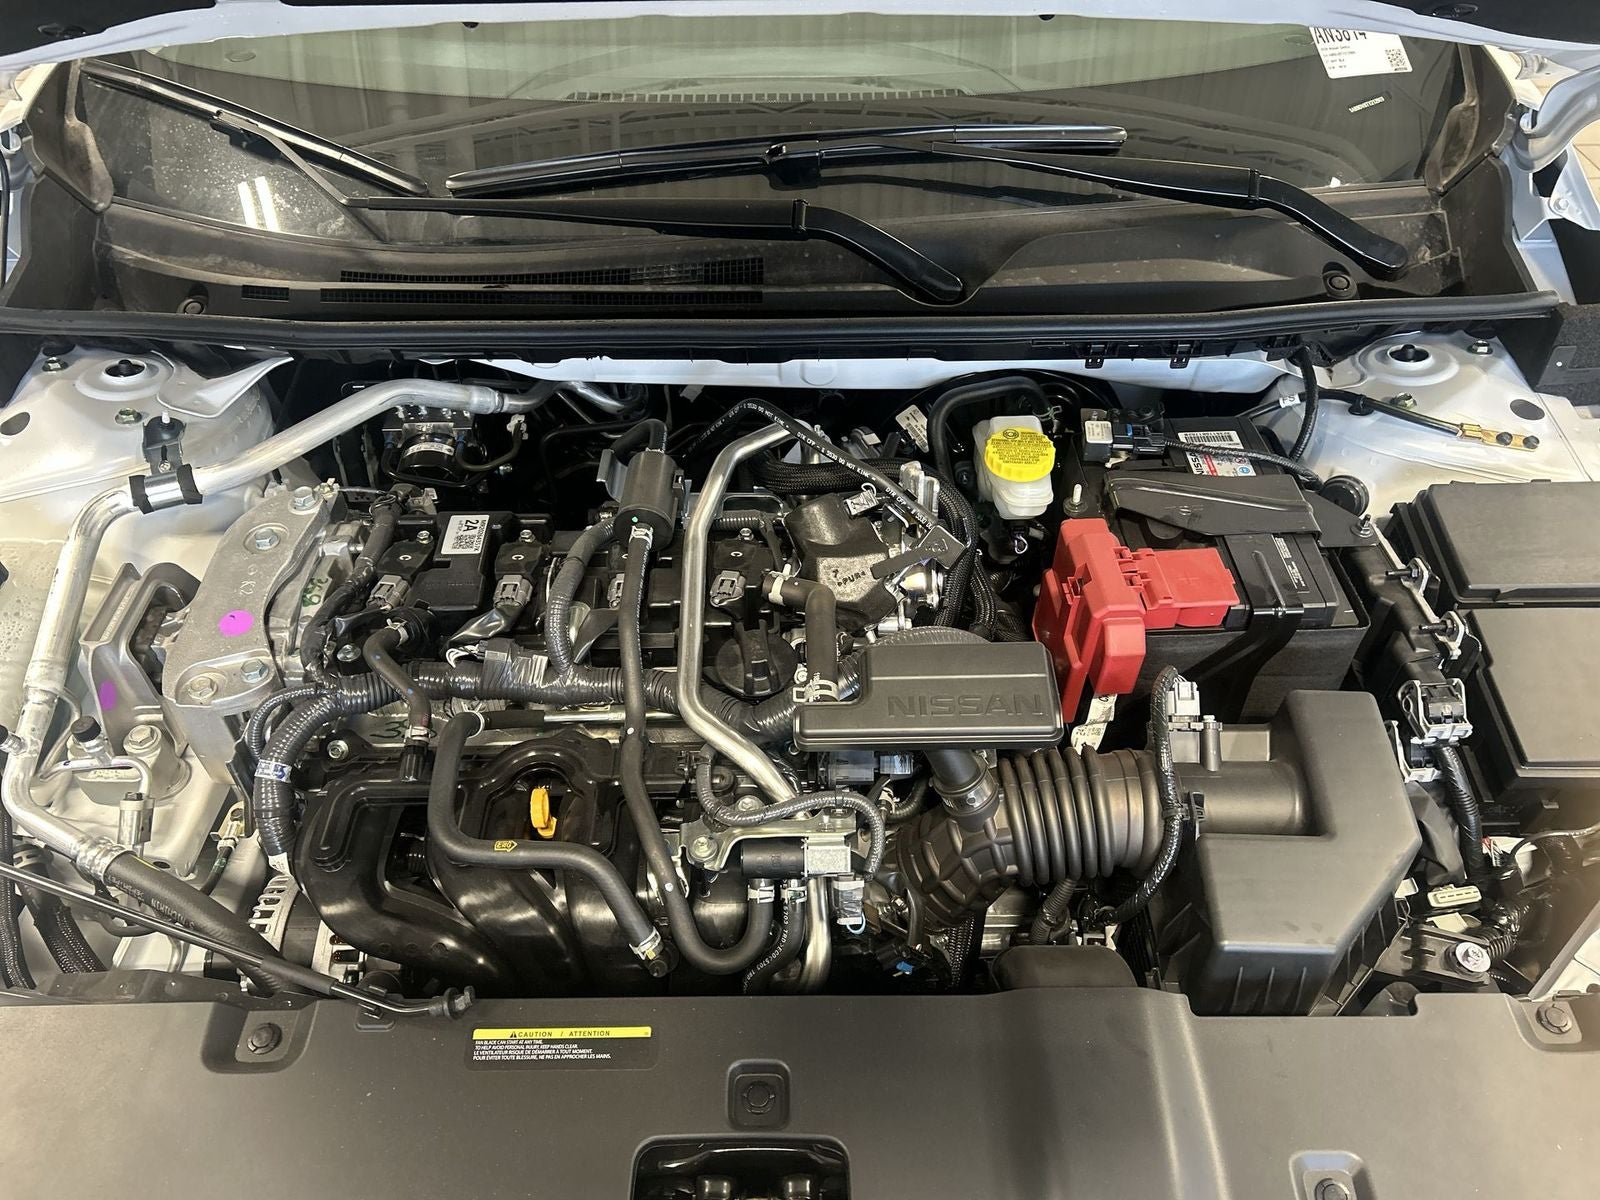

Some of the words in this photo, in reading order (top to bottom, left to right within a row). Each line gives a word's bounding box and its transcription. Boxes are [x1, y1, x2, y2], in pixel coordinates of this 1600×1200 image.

[846, 461, 856, 471] NOT
[857, 468, 870, 479] KINK
[1189, 452, 1204, 475] NISSA
[463, 519, 480, 532] 2A
[888, 694, 1043, 718] NISSAN
